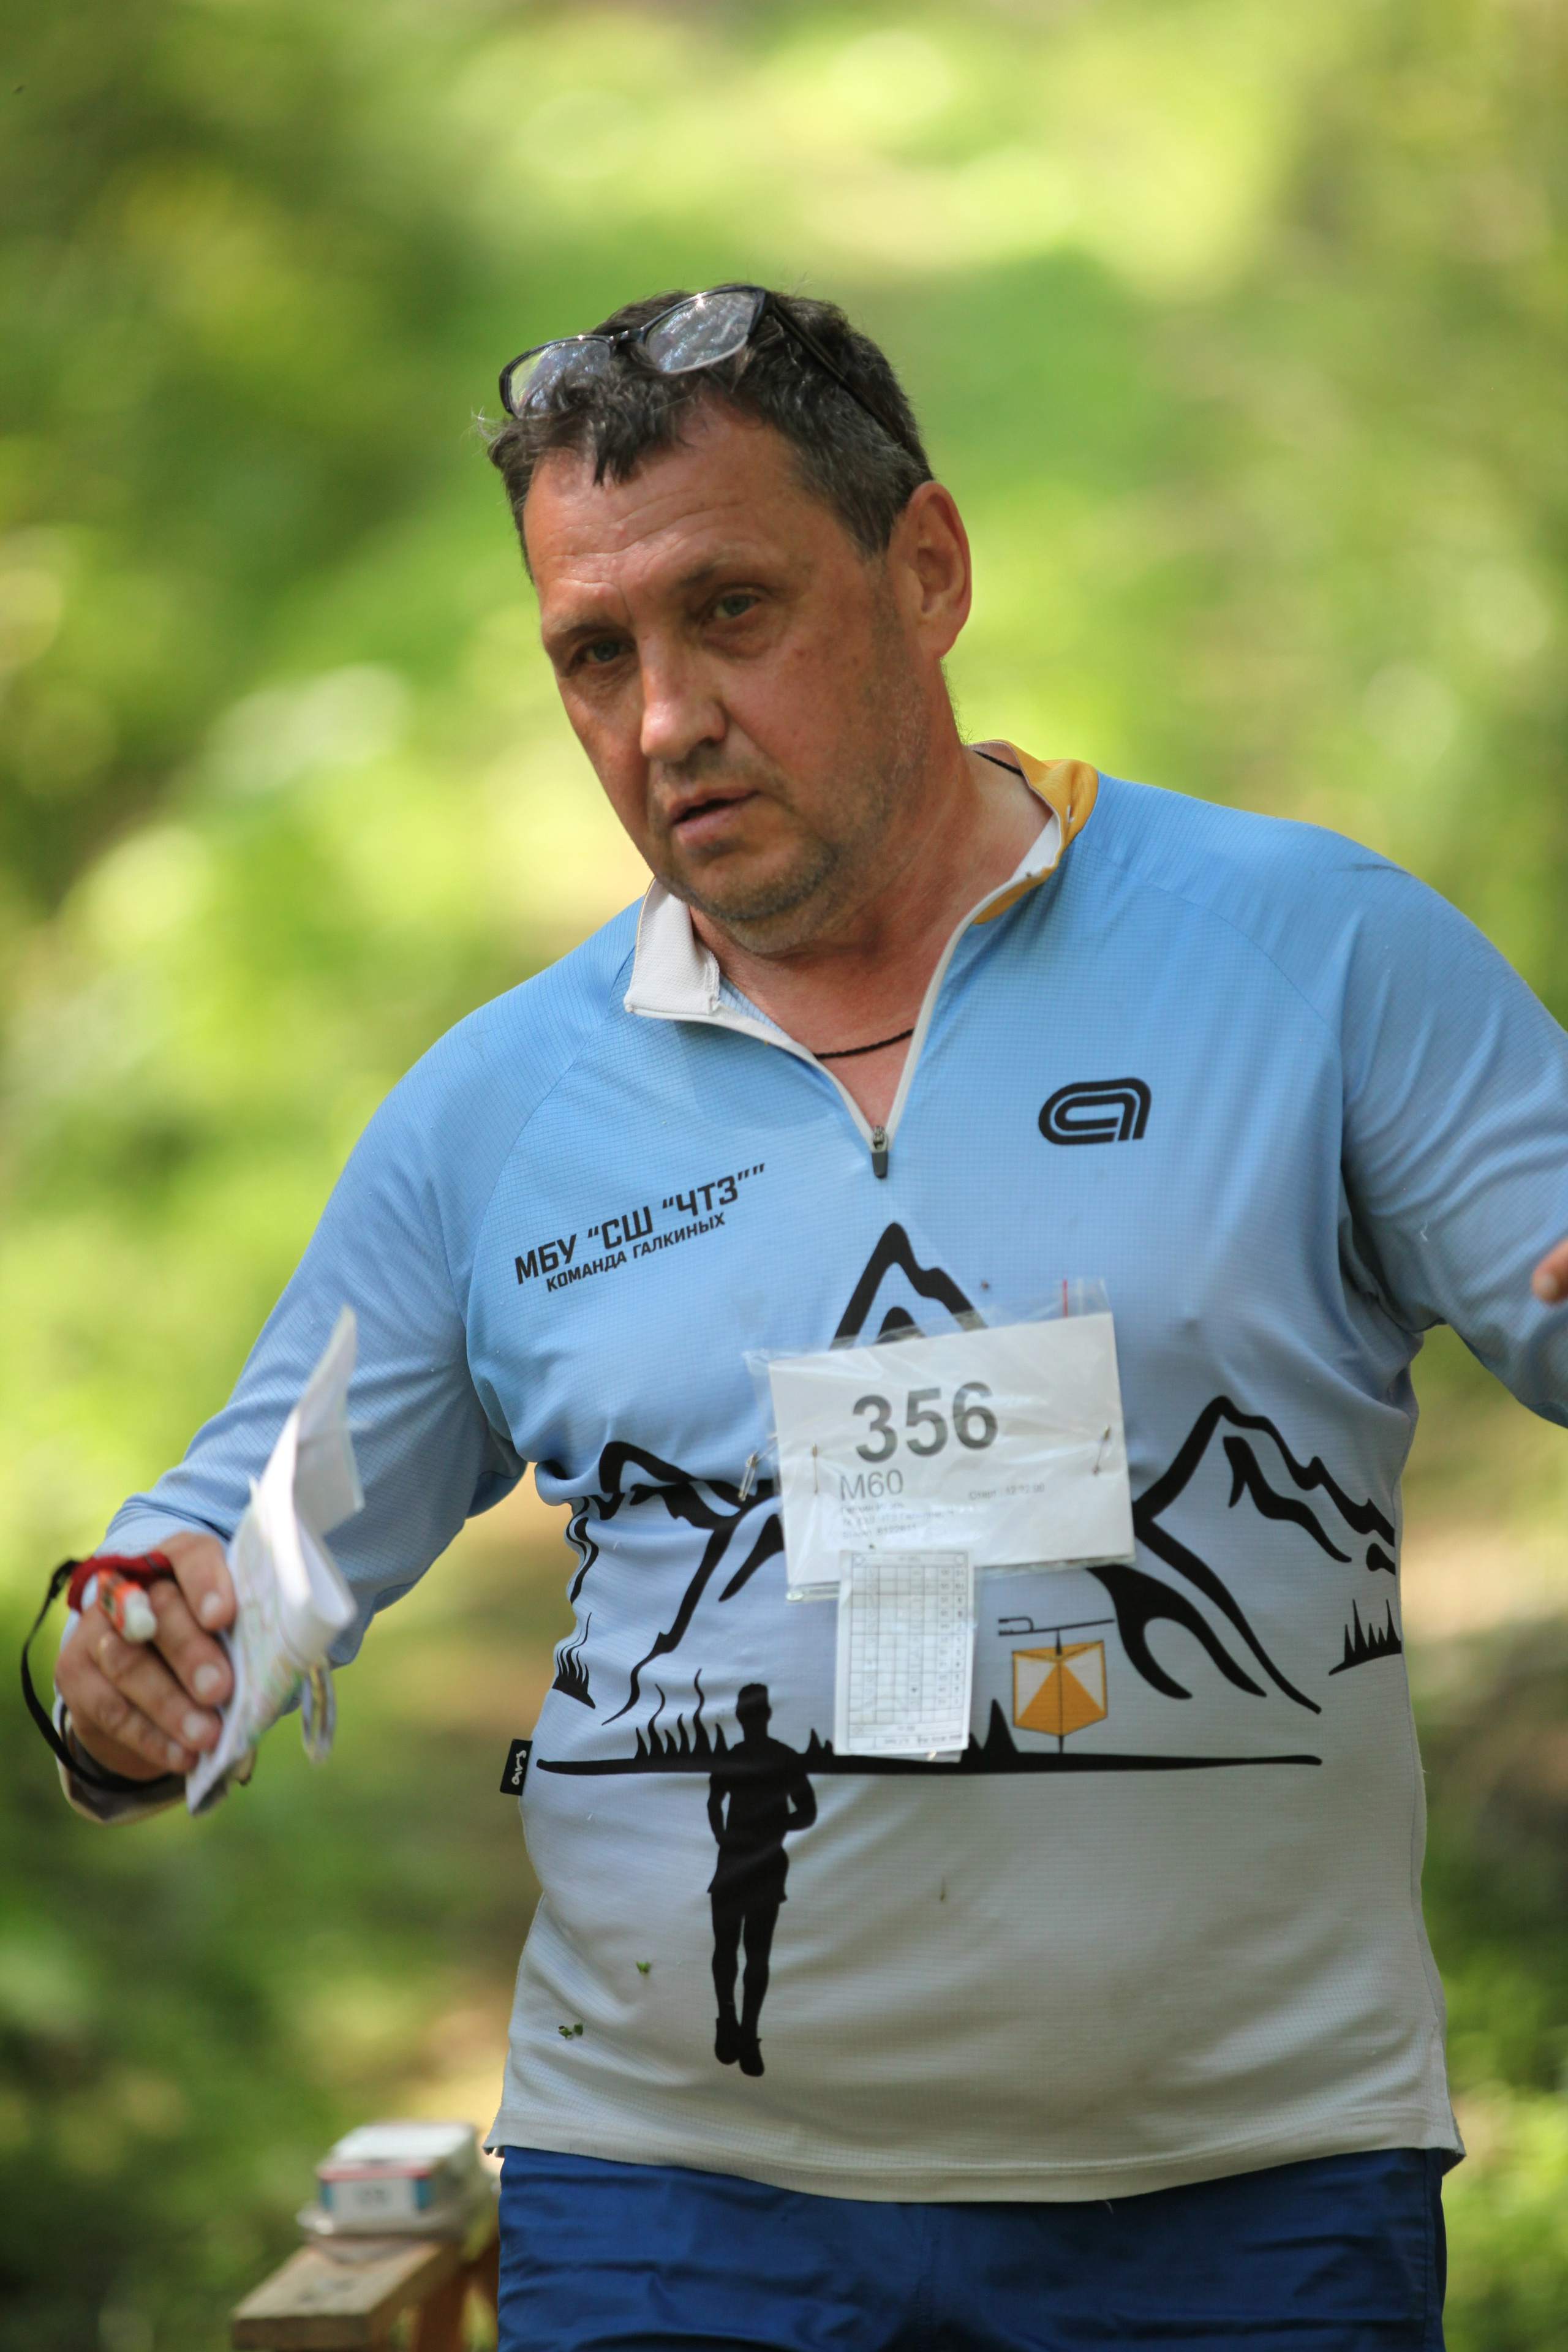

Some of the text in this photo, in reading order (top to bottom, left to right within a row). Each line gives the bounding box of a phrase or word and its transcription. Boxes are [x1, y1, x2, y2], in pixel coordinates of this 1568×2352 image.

[514, 1234, 577, 1285] МБУ
[587, 1205, 654, 1250] “СШ
[546, 1212, 726, 1292] КОМАНДА ГАЛКИНЫХ
[852, 1381, 998, 1463] 356
